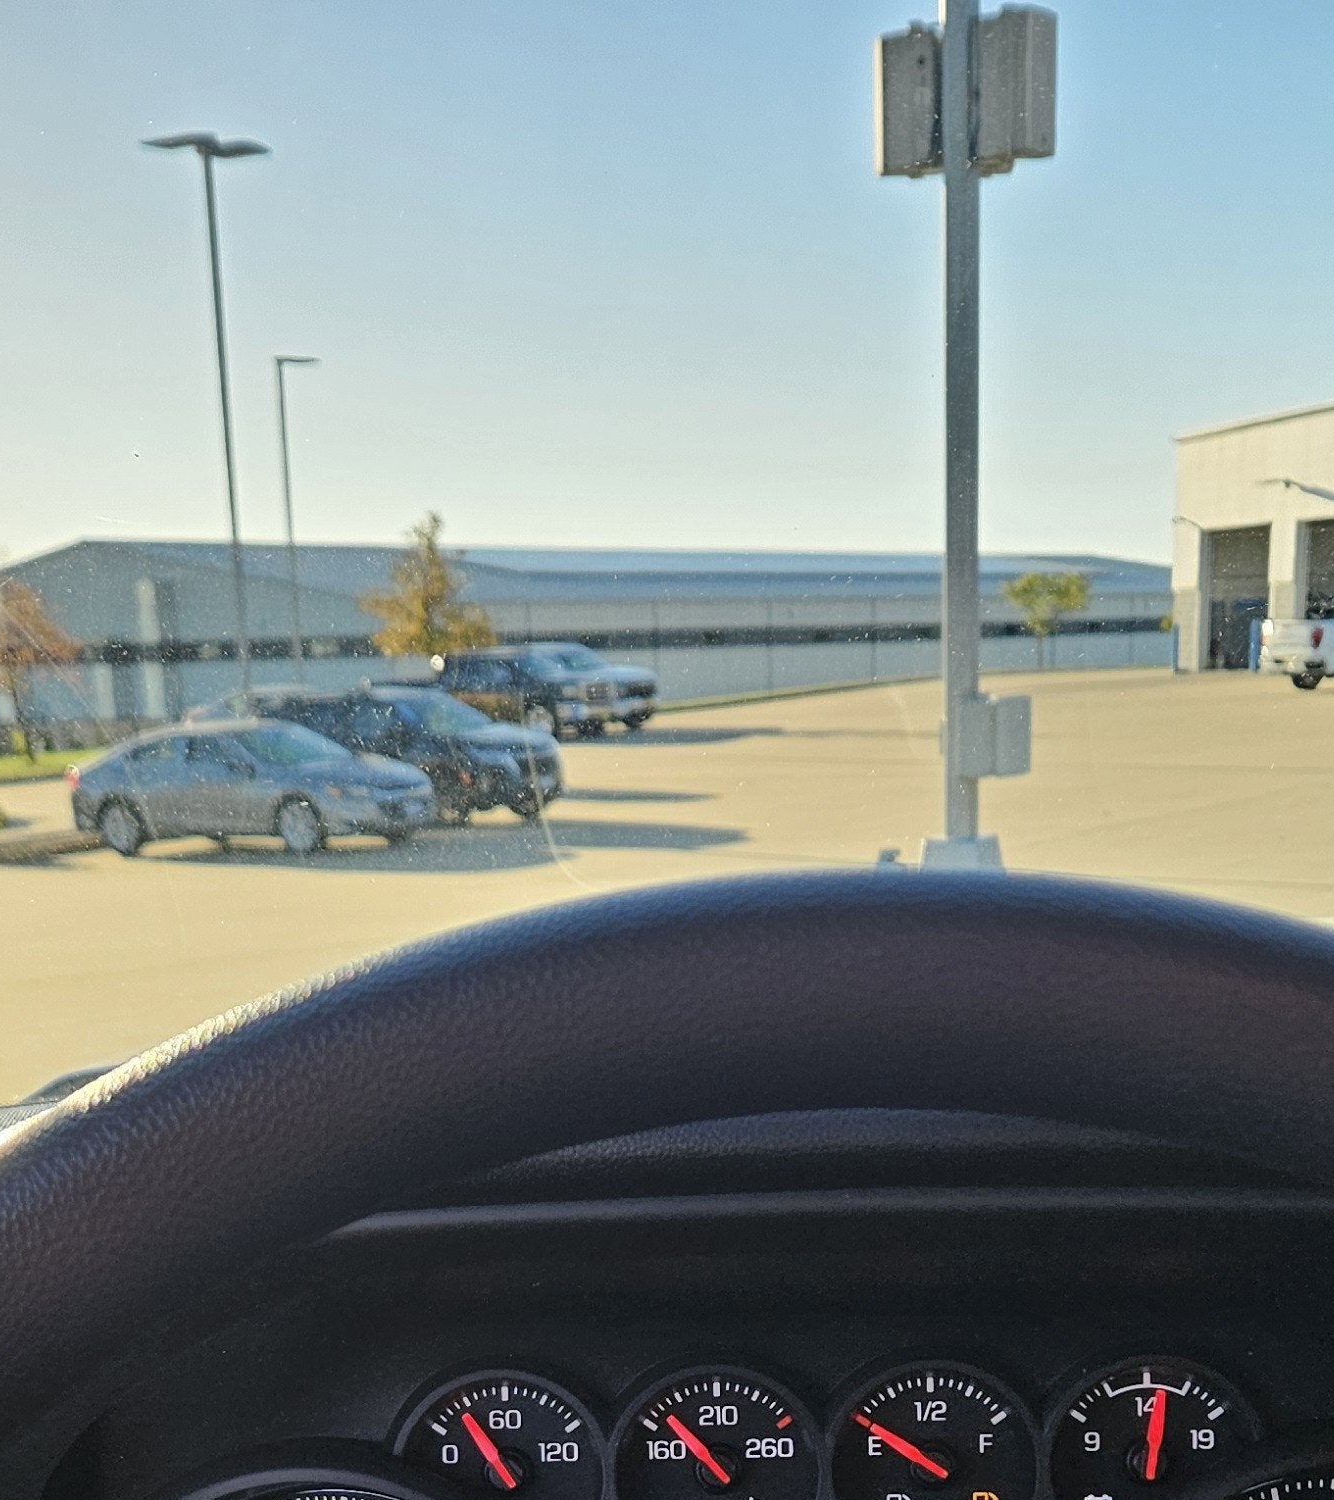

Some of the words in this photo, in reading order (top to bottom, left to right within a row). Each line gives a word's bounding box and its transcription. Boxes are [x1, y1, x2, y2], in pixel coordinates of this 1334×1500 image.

[488, 1409, 522, 1430] 60
[698, 1405, 739, 1427] 210
[913, 1400, 947, 1422] 1/2
[646, 1439, 687, 1461] 160
[745, 1437, 794, 1459] 260
[867, 1435, 883, 1457] E
[979, 1433, 994, 1454] F
[1084, 1431, 1101, 1452] 9
[1189, 1428, 1215, 1450] 19
[441, 1444, 459, 1464] 0
[537, 1441, 579, 1463] 120
